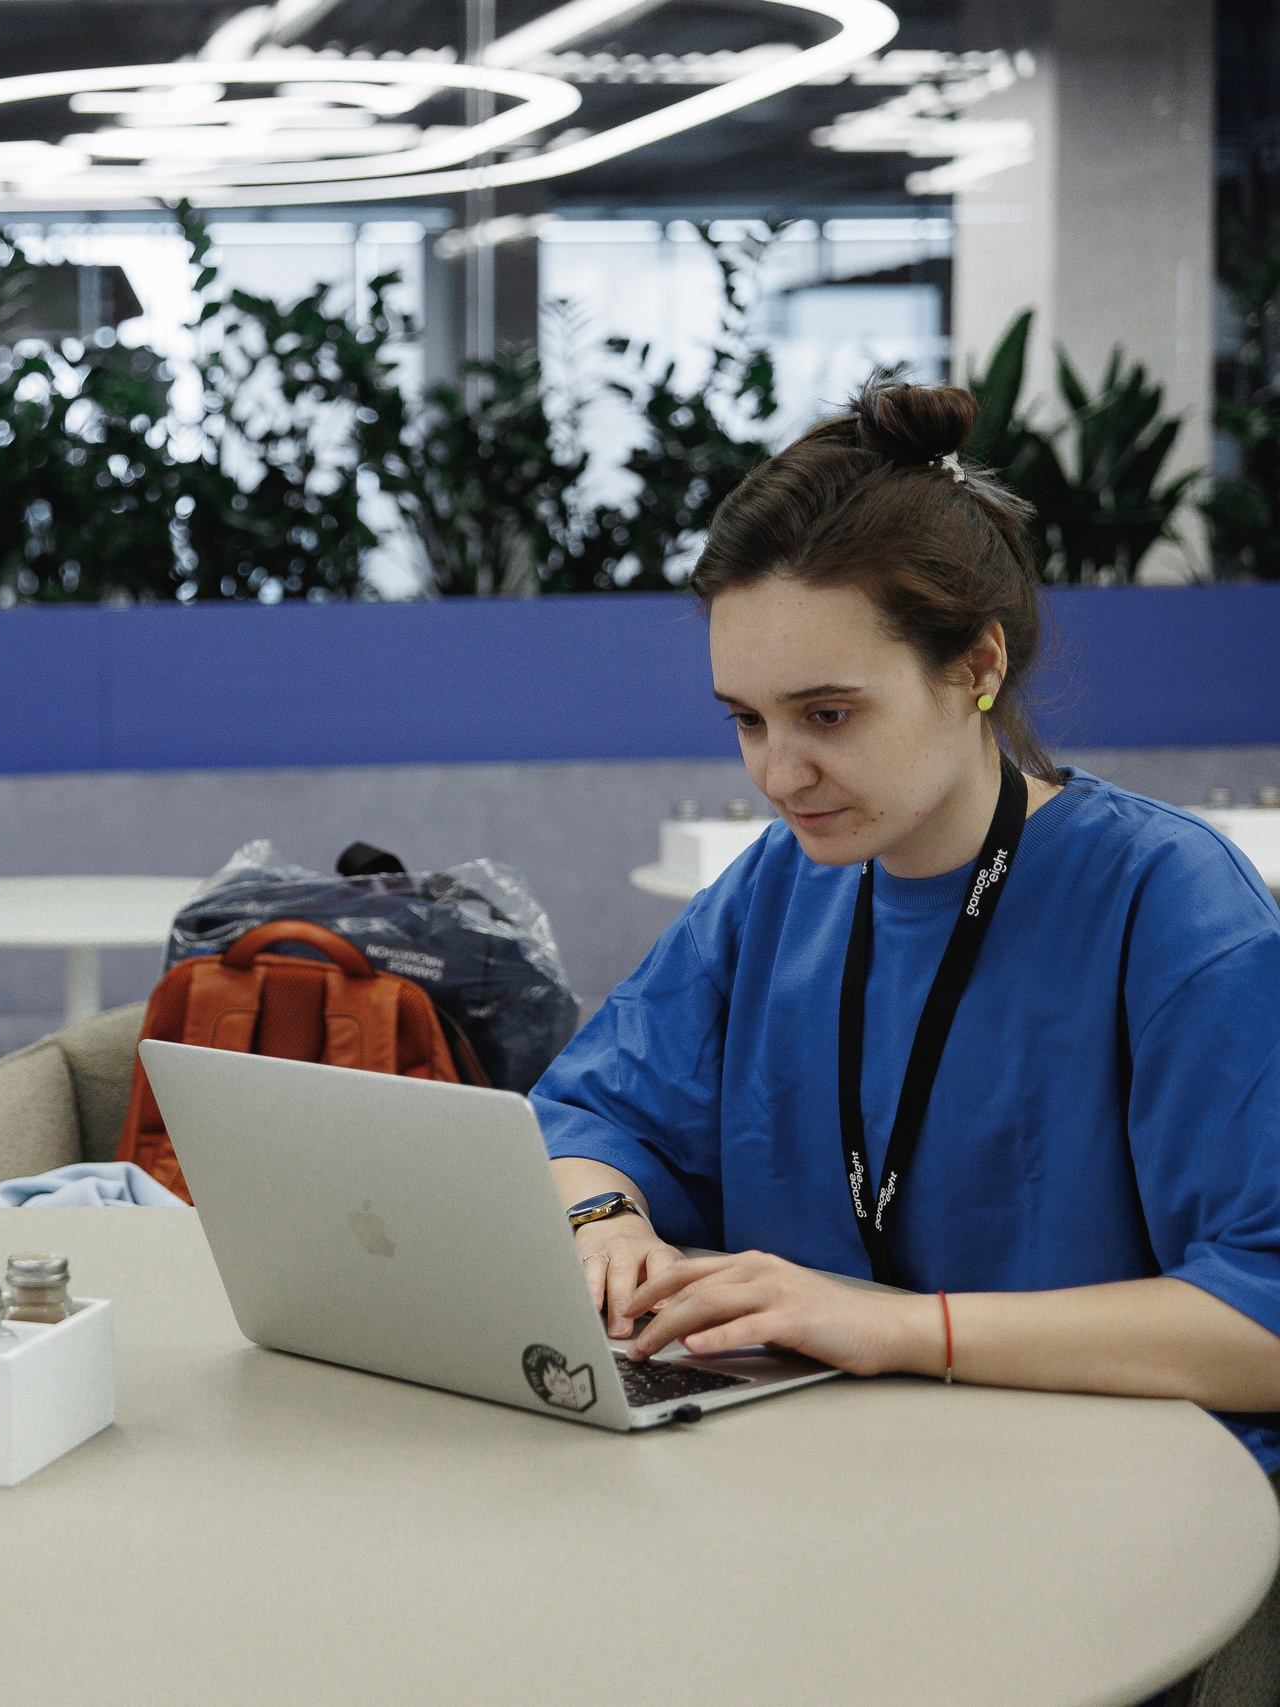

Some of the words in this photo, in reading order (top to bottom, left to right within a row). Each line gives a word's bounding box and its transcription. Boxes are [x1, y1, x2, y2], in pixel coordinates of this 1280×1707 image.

[989, 848, 1008, 882] eight
[966, 868, 990, 917] garage
[851, 1151, 864, 1183] eight
[885, 1171, 897, 1202] eight
[849, 1173, 867, 1218] garage
[875, 1187, 887, 1232] garage
